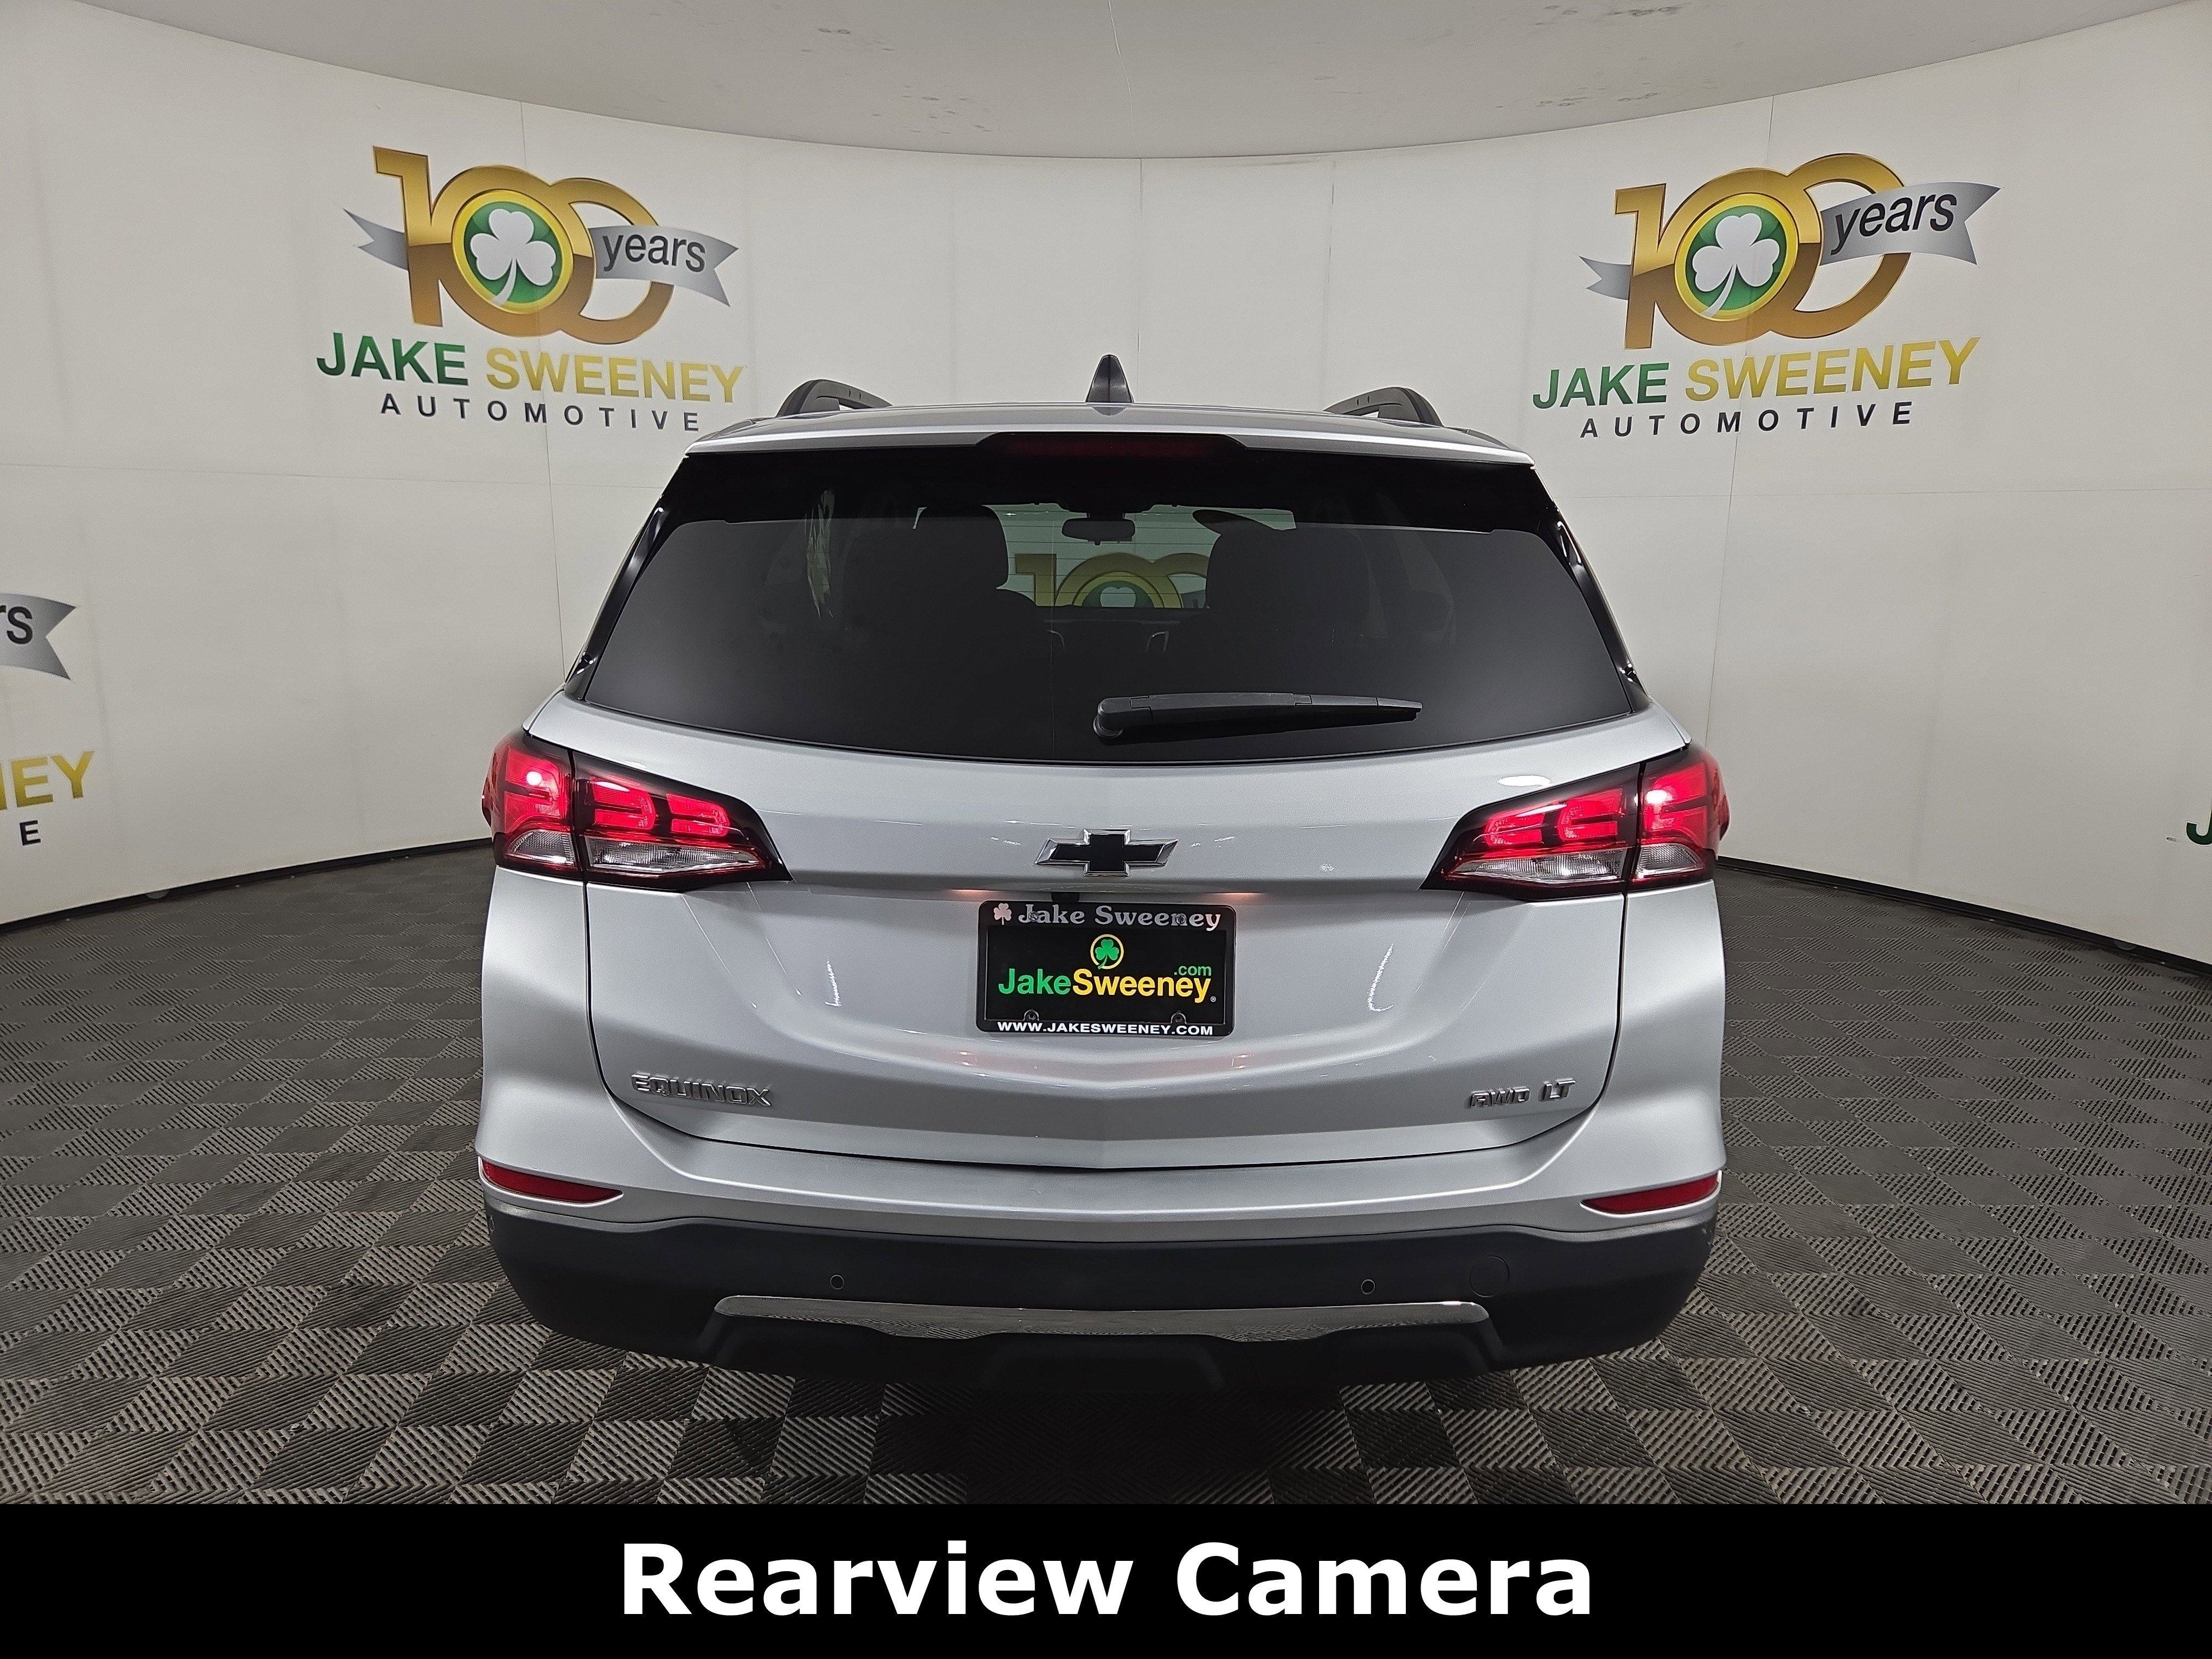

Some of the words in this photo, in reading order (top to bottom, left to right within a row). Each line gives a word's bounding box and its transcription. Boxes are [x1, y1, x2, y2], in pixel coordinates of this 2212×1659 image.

[1830, 193, 1957, 256] years
[372, 145, 674, 345] 100
[602, 232, 706, 273] years
[1615, 152, 1912, 350] 100
[317, 332, 466, 386] JAKE
[486, 348, 744, 403] SWEENEY
[1532, 362, 1670, 409] JAKE
[1685, 337, 1982, 402] SWEENEY
[381, 393, 699, 432] AUTOMOTIVE
[1580, 401, 1913, 438] AUTOMOTIVE
[1018, 904, 1085, 924] Jake
[1095, 905, 1221, 931] Sweeney
[998, 1021, 1213, 1036] WWW.JAKESWEENEY.COM
[631, 1073, 771, 1106] EQUINOX
[1471, 1088, 1530, 1108] AWD
[1544, 1080, 1576, 1099] LT
